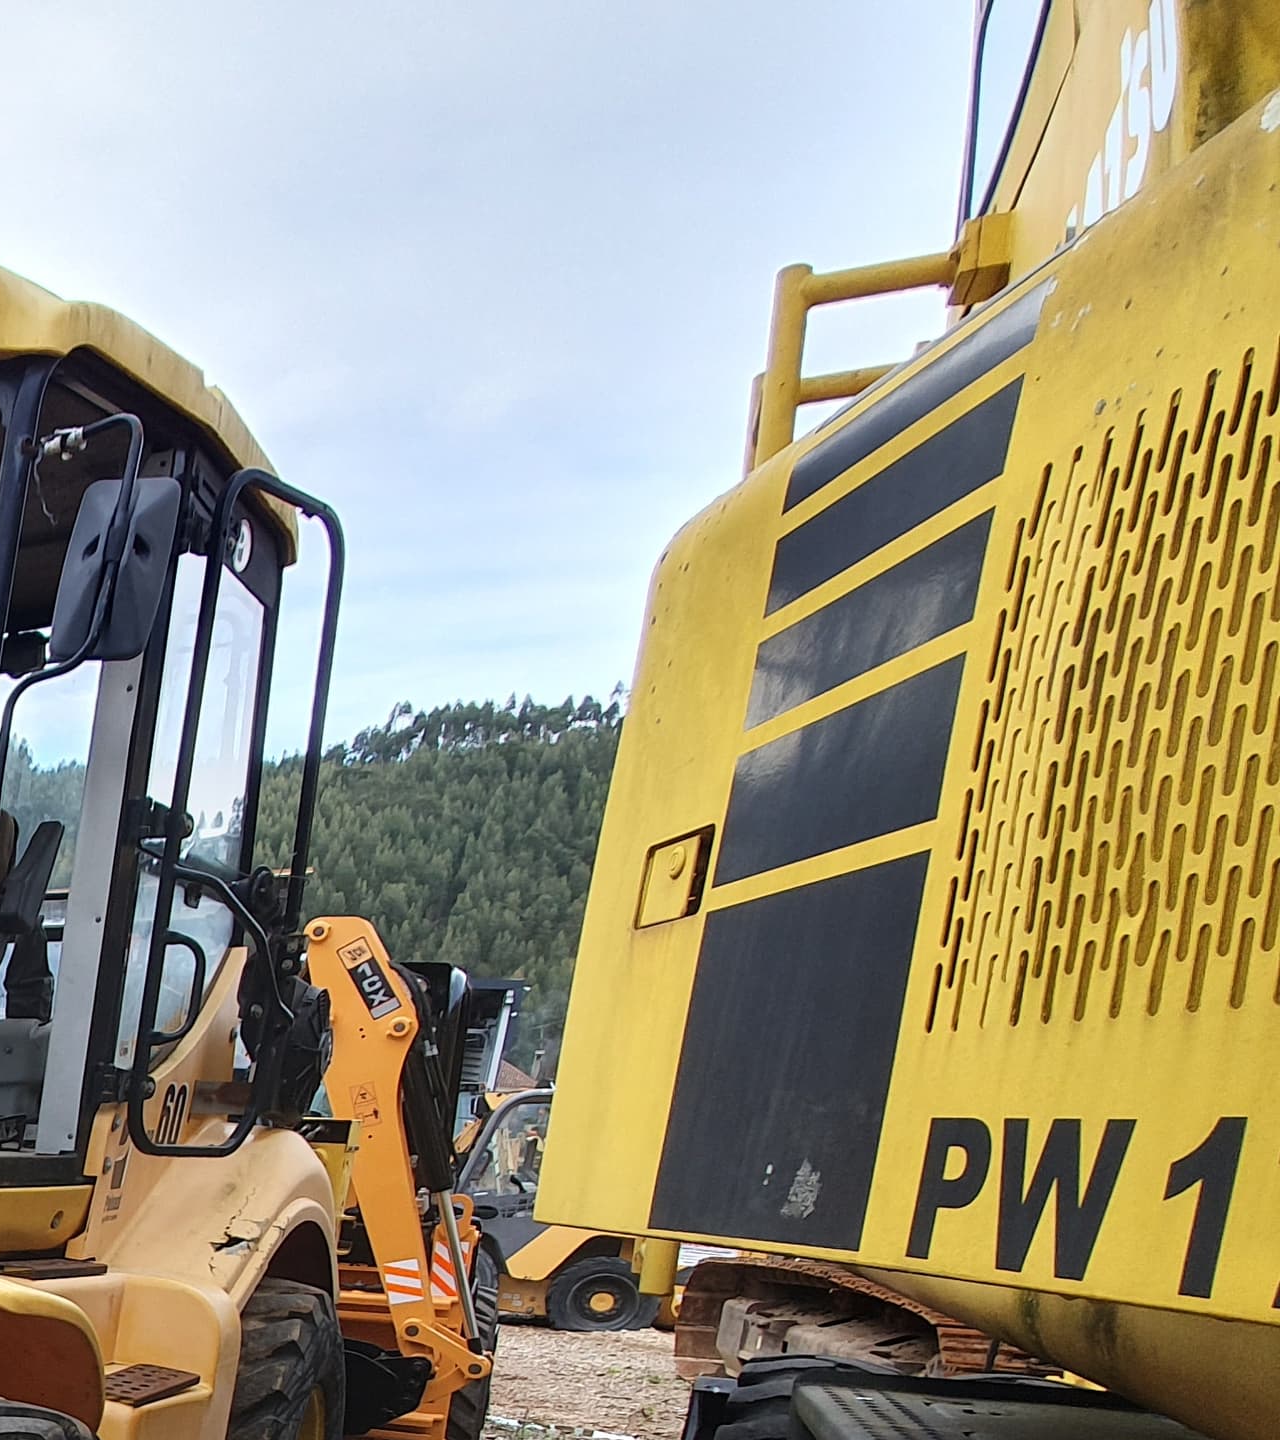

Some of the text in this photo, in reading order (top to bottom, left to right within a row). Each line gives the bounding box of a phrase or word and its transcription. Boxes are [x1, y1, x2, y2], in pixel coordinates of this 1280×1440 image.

[155, 1082, 188, 1145] 60
[904, 1115, 1280, 1310] PW 1
